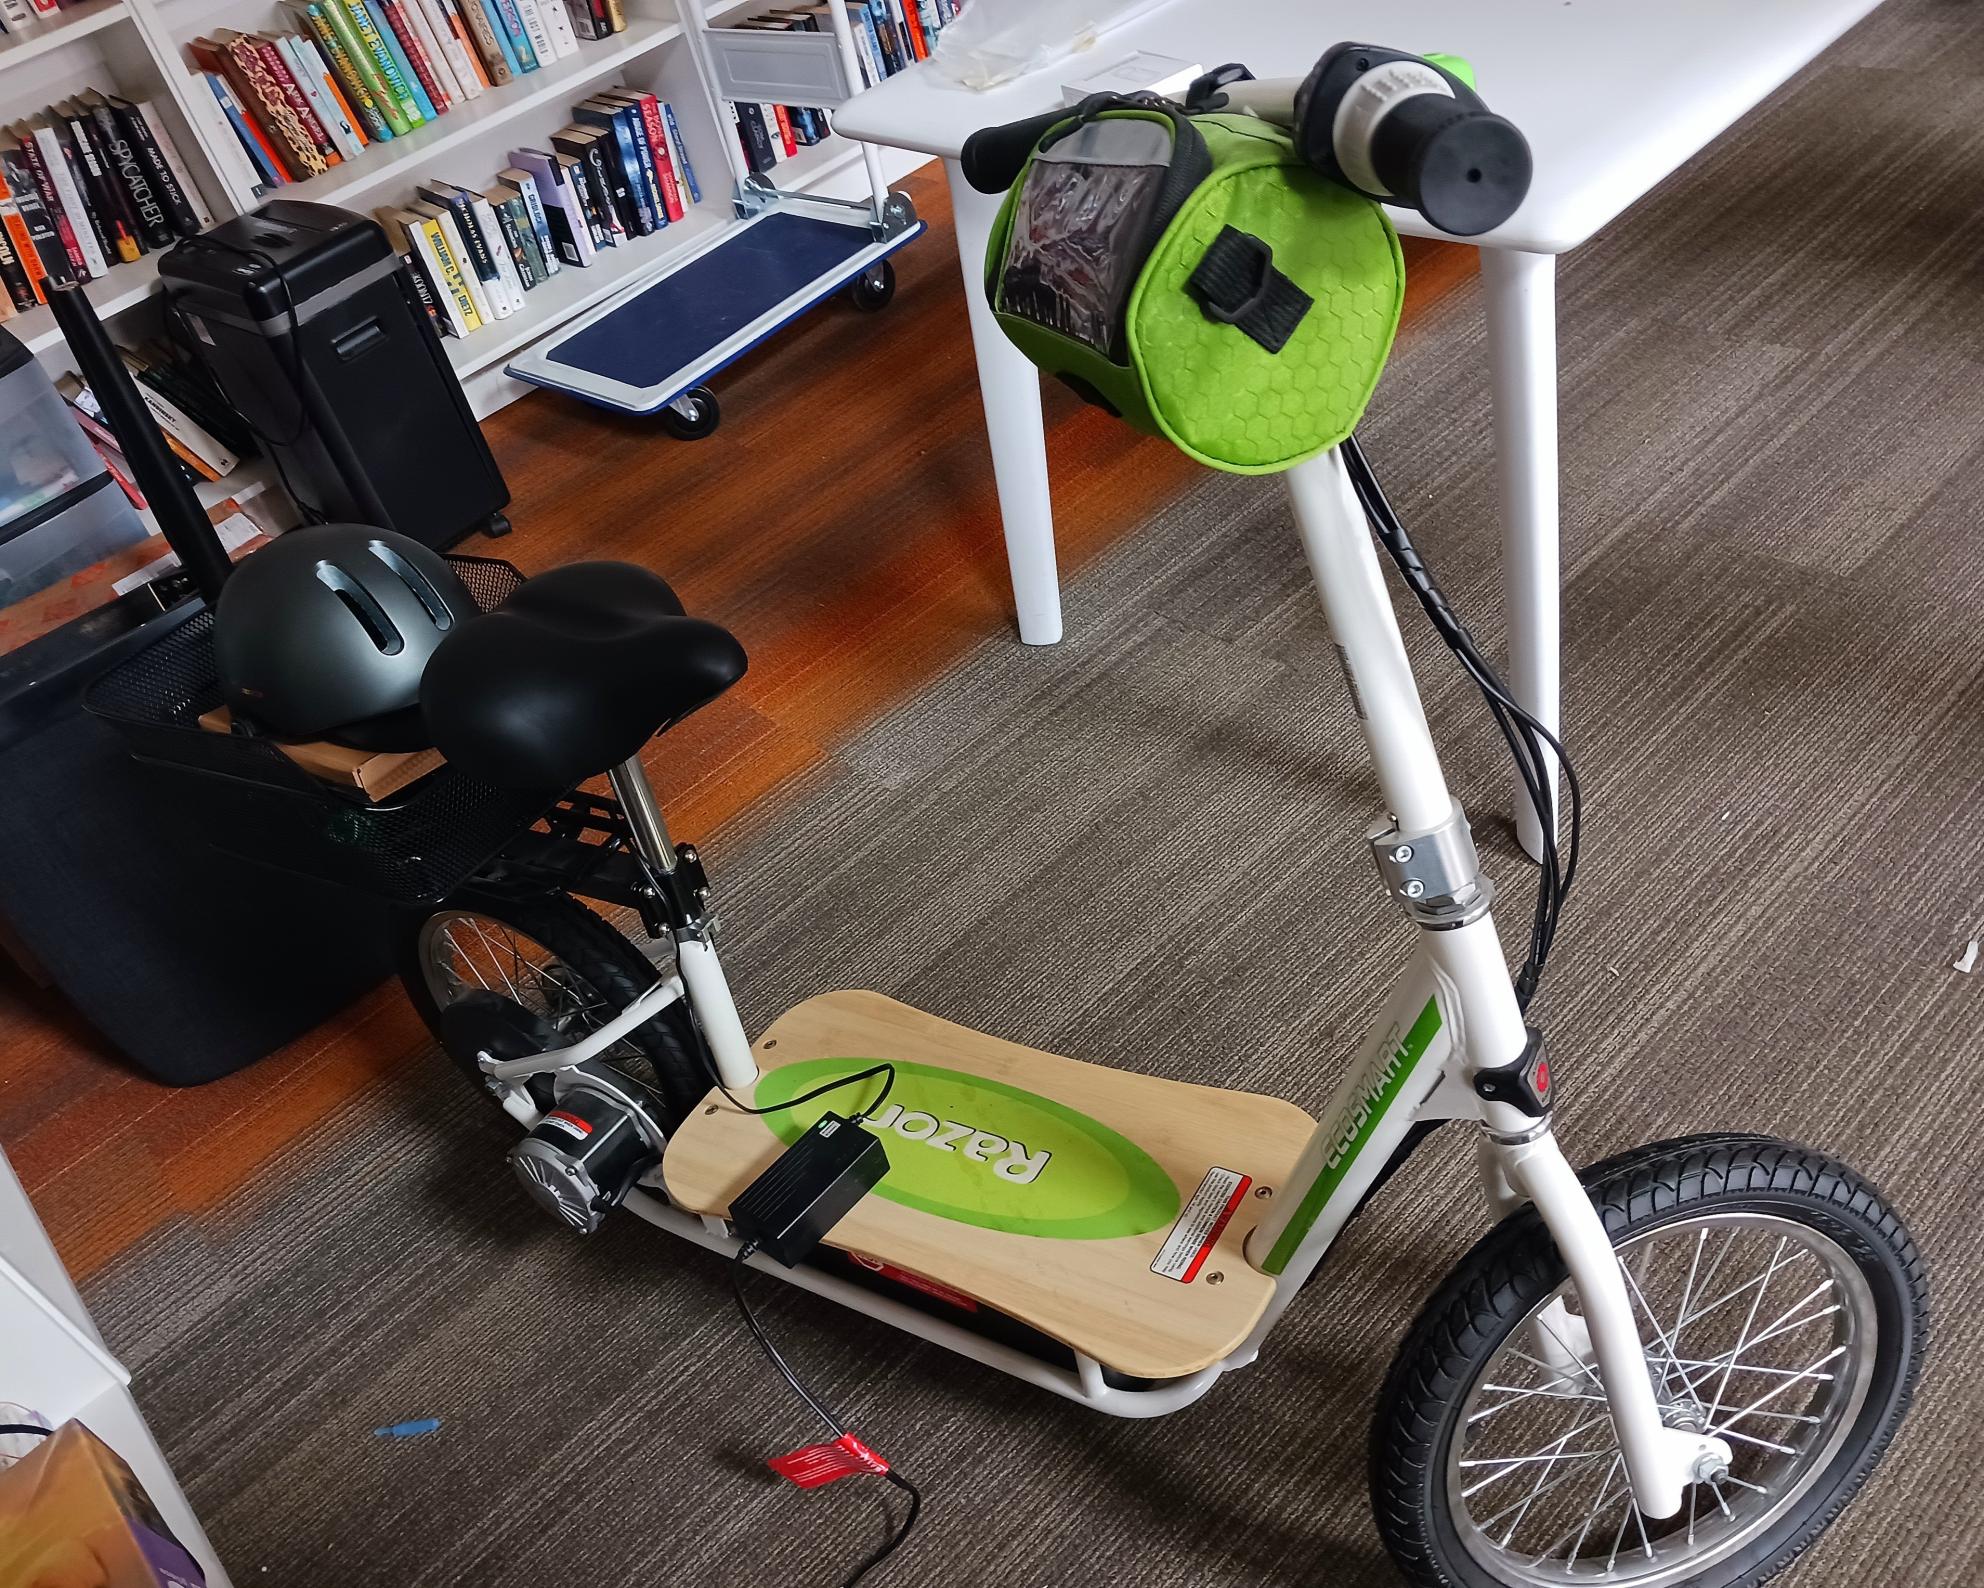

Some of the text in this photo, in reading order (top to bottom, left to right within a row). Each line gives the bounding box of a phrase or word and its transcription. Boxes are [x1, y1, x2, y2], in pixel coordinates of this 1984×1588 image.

[350, 3, 375, 38] JANET
[369, 40, 410, 101] EVANOVICH
[108, 140, 164, 228] SPYCATCHER
[147, 147, 182, 205] MADE TO STICK
[413, 273, 433, 304] KOONTZ
[458, 294, 473, 316] DIETZ
[1320, 1022, 1409, 1170] ECOSMART
[864, 1103, 1053, 1185] Razor
